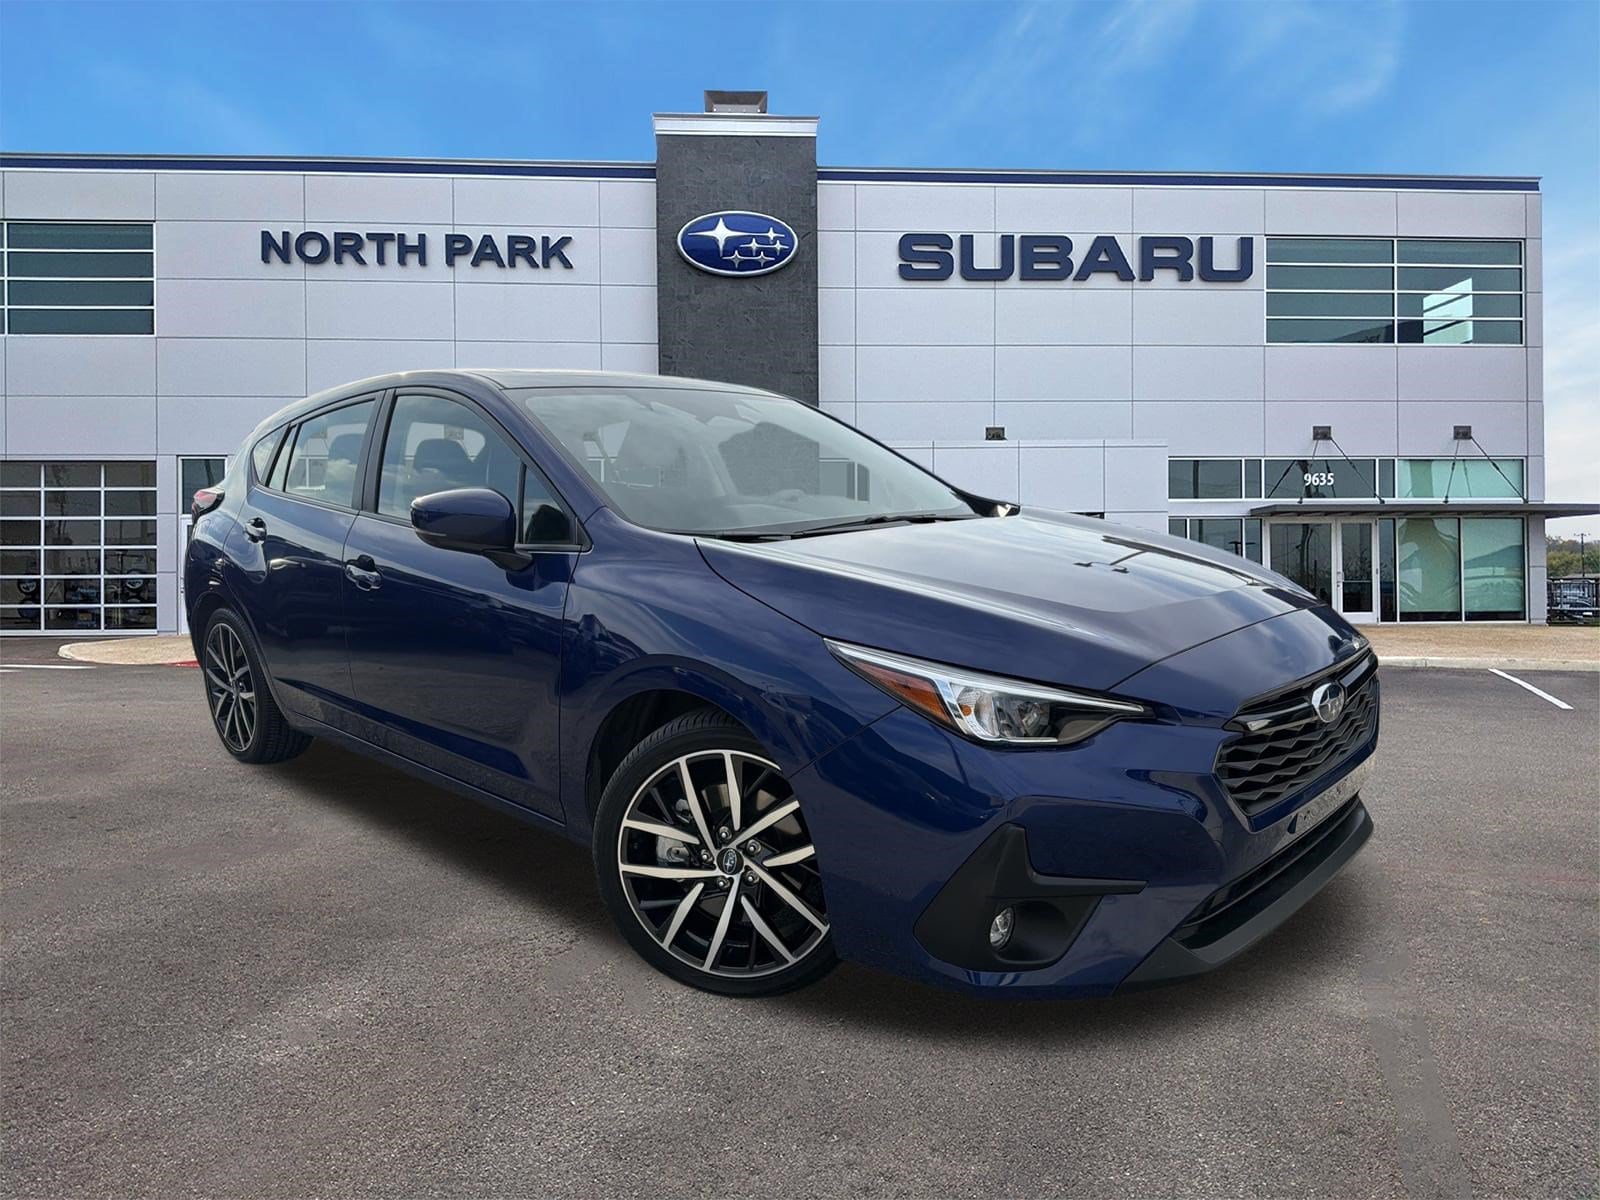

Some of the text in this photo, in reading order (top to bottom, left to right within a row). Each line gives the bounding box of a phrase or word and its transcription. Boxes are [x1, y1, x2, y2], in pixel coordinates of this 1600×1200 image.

[261, 230, 573, 269] NORTH PARK
[898, 233, 1254, 282] SUBARU
[1303, 472, 1335, 486] 9635
